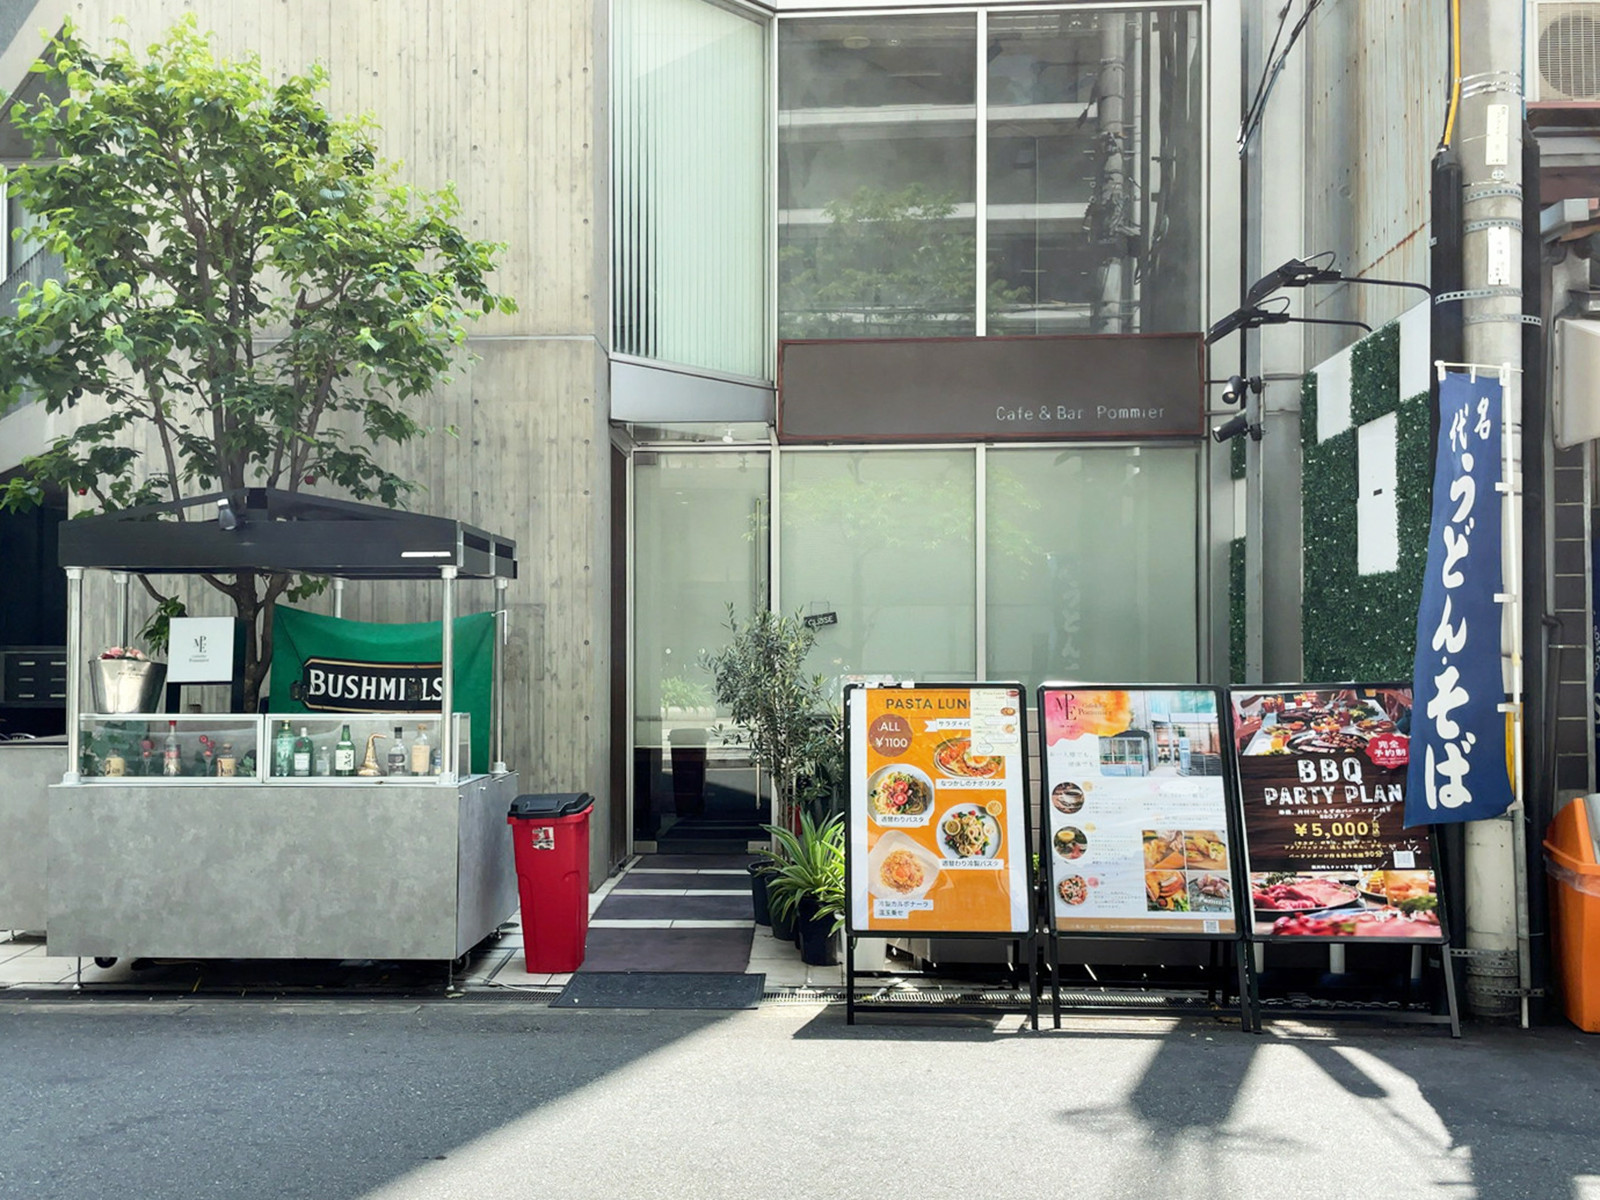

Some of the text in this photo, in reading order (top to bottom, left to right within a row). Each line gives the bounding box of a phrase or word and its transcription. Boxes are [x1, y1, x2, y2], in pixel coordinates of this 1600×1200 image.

[996, 405, 1165, 421] Cafe & Bar Pommier
[309, 669, 442, 702] BUSHMILS
[885, 698, 971, 710] PASTA LUN
[880, 722, 901, 732] ALL
[875, 736, 908, 748] ¥1100
[1297, 757, 1363, 785] BBQ
[1264, 783, 1403, 806] PARTY PLAN
[1294, 822, 1369, 839] ¥5,000
